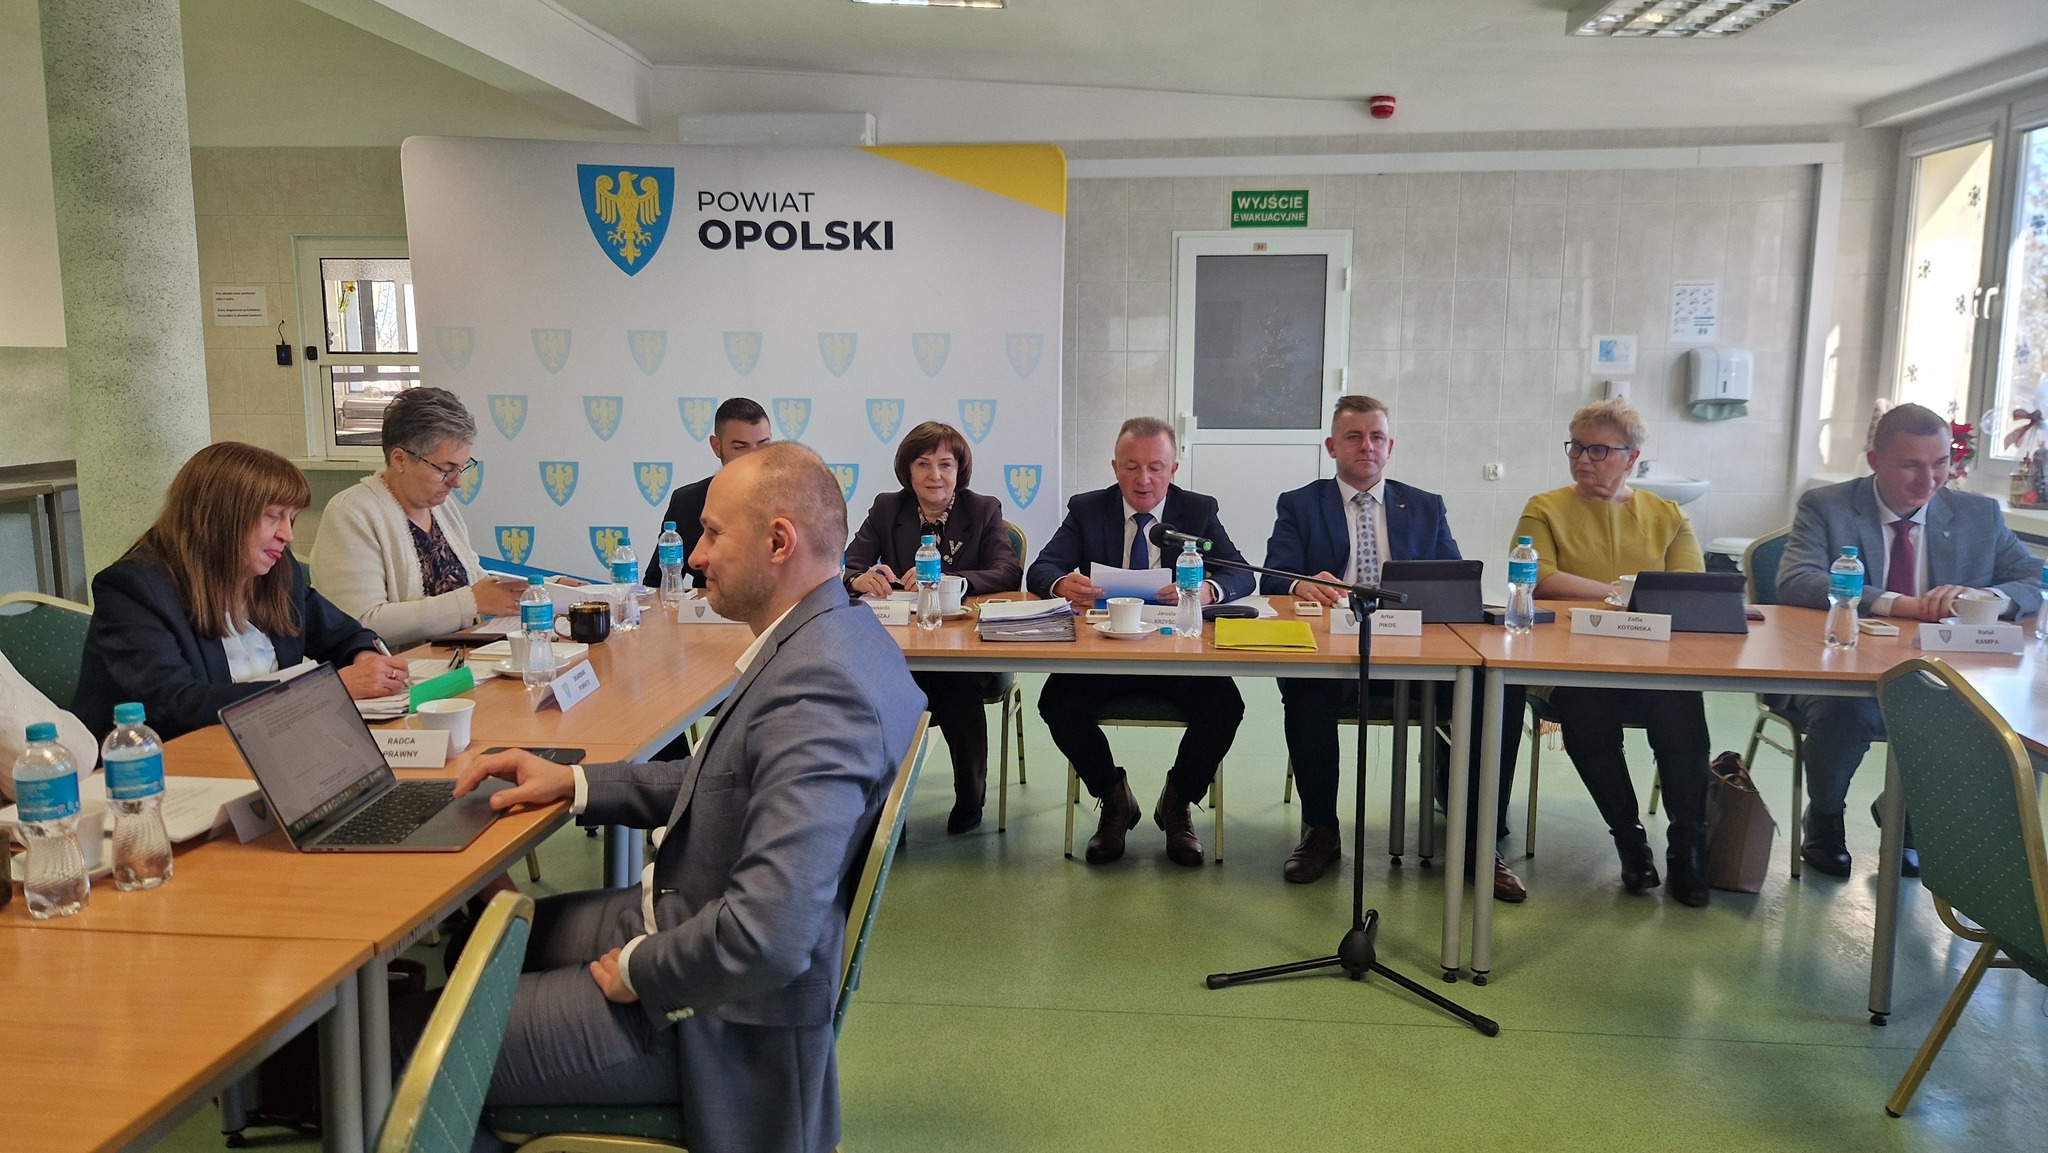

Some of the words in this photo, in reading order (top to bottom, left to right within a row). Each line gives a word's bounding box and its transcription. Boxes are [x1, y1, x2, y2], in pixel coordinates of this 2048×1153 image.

[698, 191, 815, 213] POWIAT
[1237, 194, 1303, 209] WYJŚCIE
[1233, 212, 1305, 222] EWAKUACYJNE
[698, 219, 894, 250] OPOLSKI
[387, 737, 416, 745] RADCA
[383, 750, 419, 758] PRAWNY
